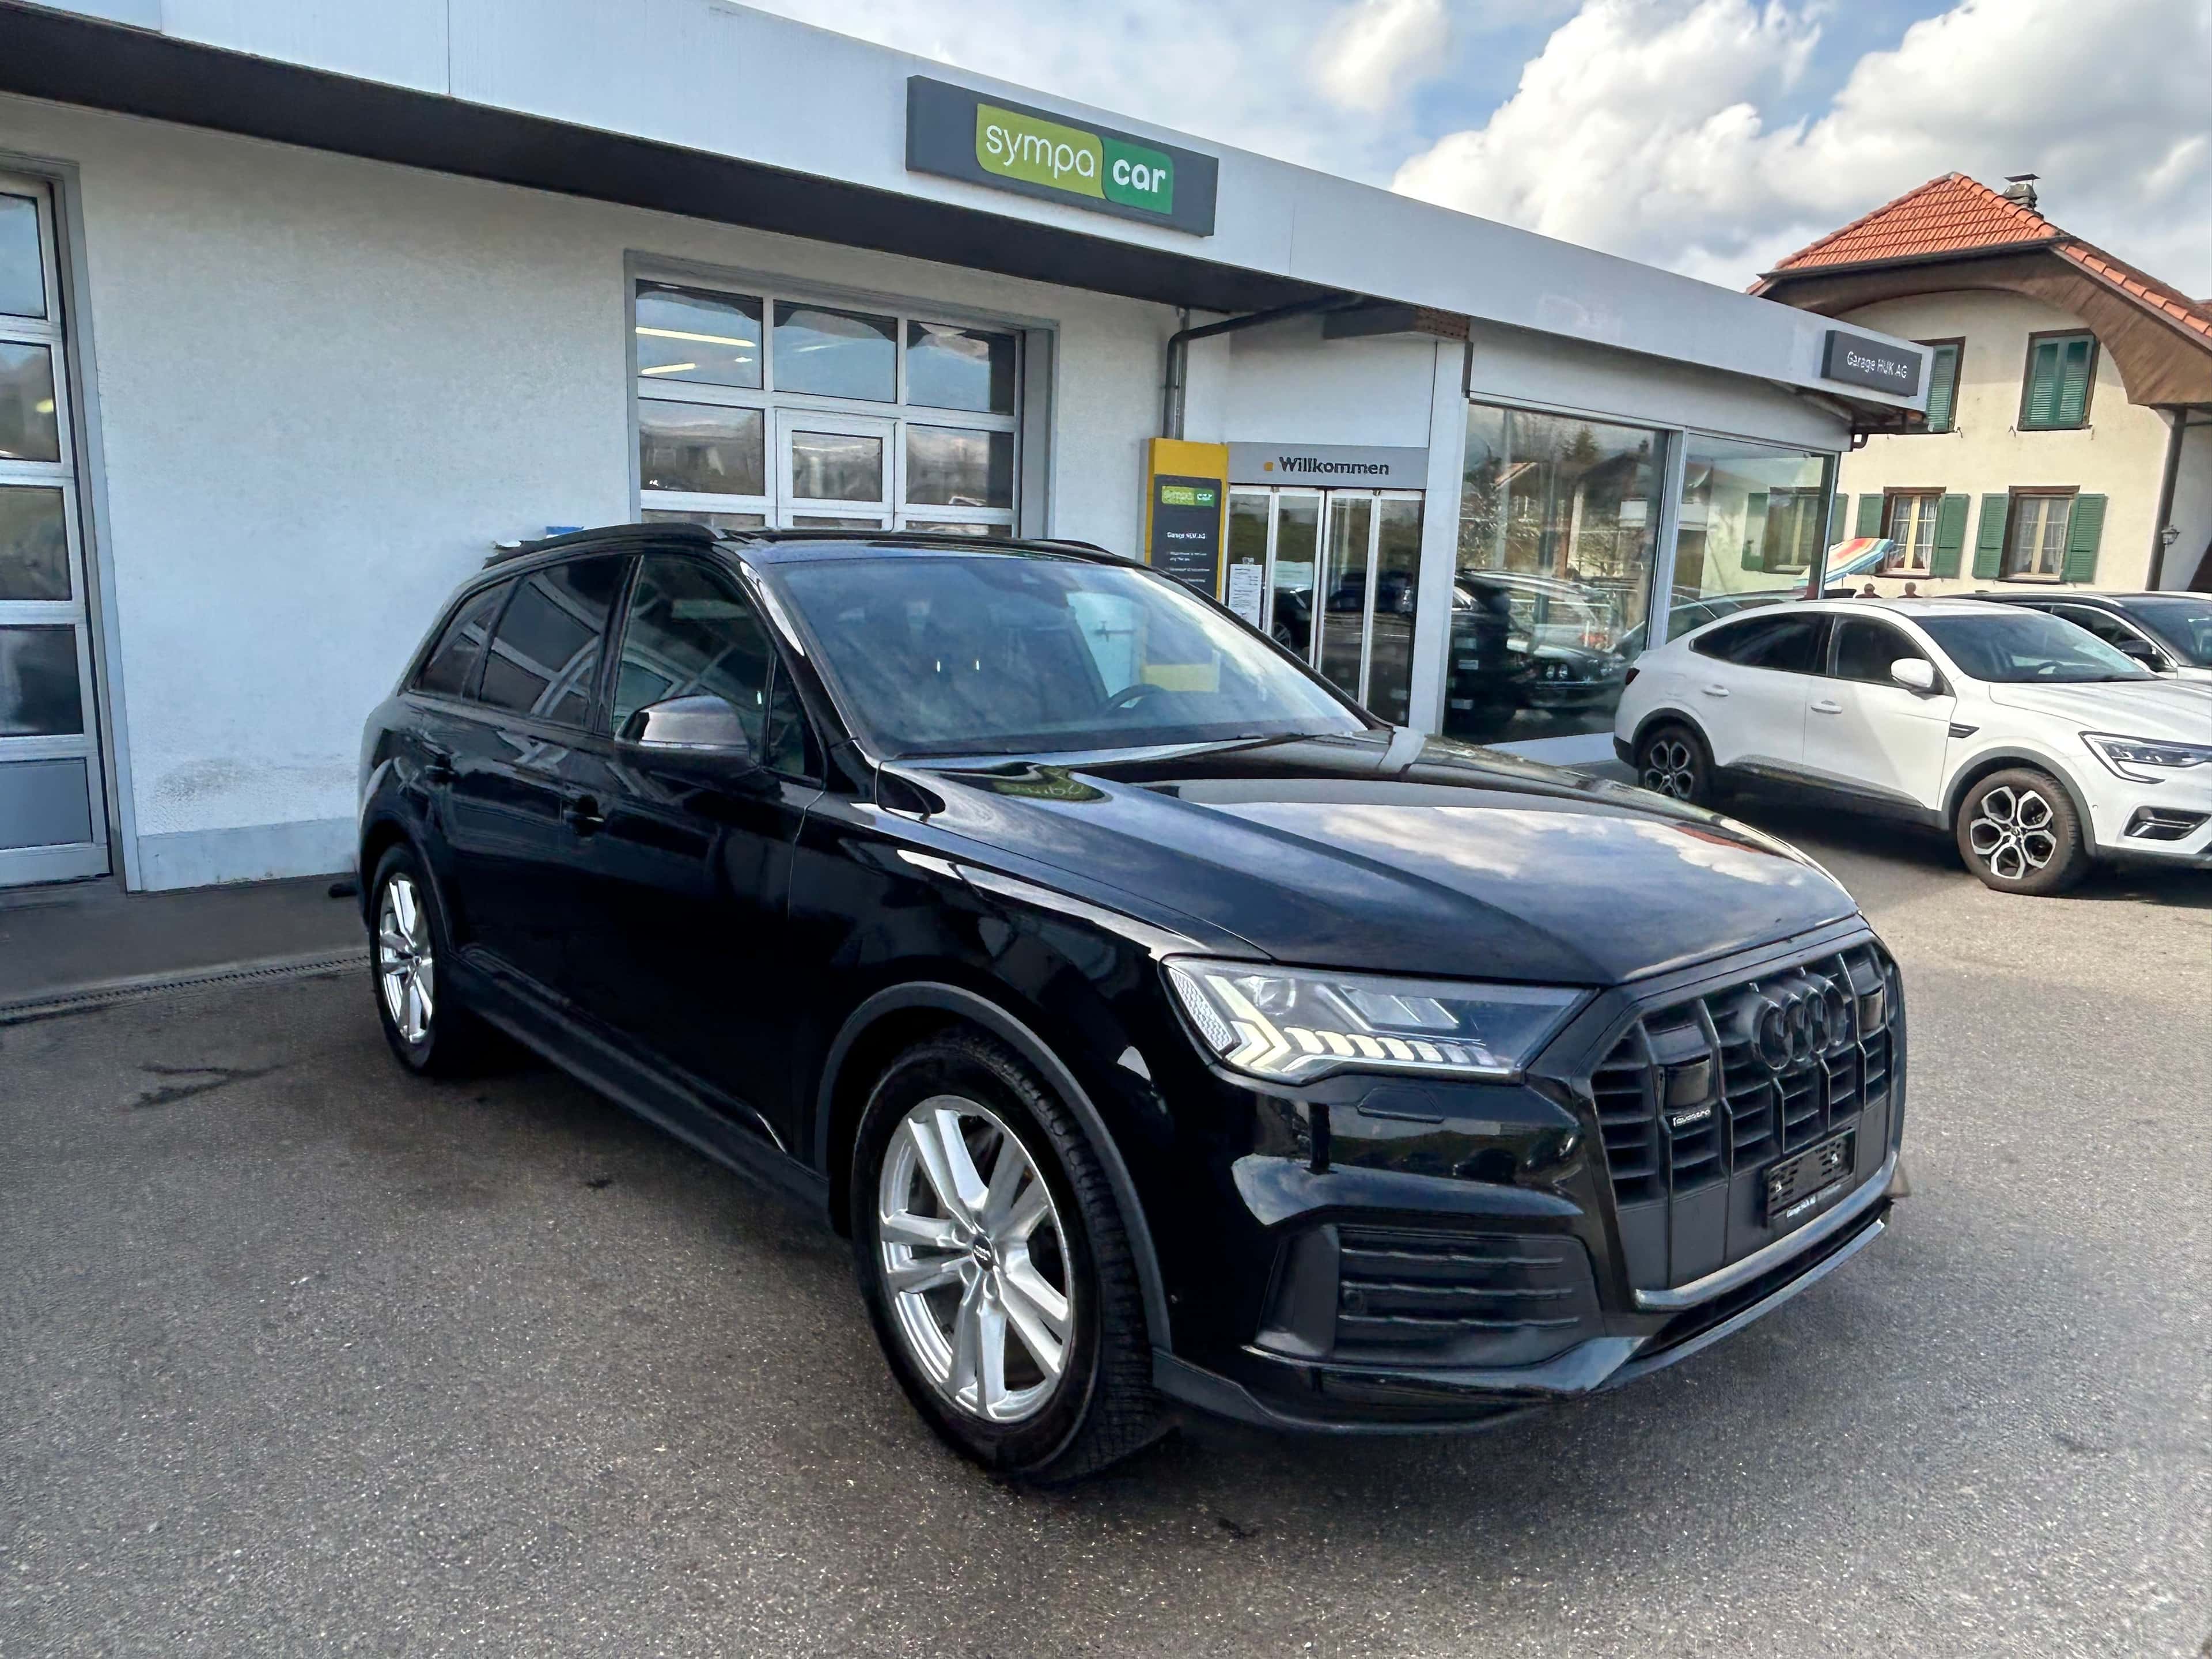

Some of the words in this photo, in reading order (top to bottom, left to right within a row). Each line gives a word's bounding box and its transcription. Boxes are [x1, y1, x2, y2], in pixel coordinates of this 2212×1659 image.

[985, 124, 1095, 179] sympa
[1112, 158, 1166, 193] car
[1847, 351, 1876, 373] Garage
[1877, 359, 1895, 375] HUK
[1895, 365, 1908, 378] AG
[1279, 456, 1389, 475] Willkommen
